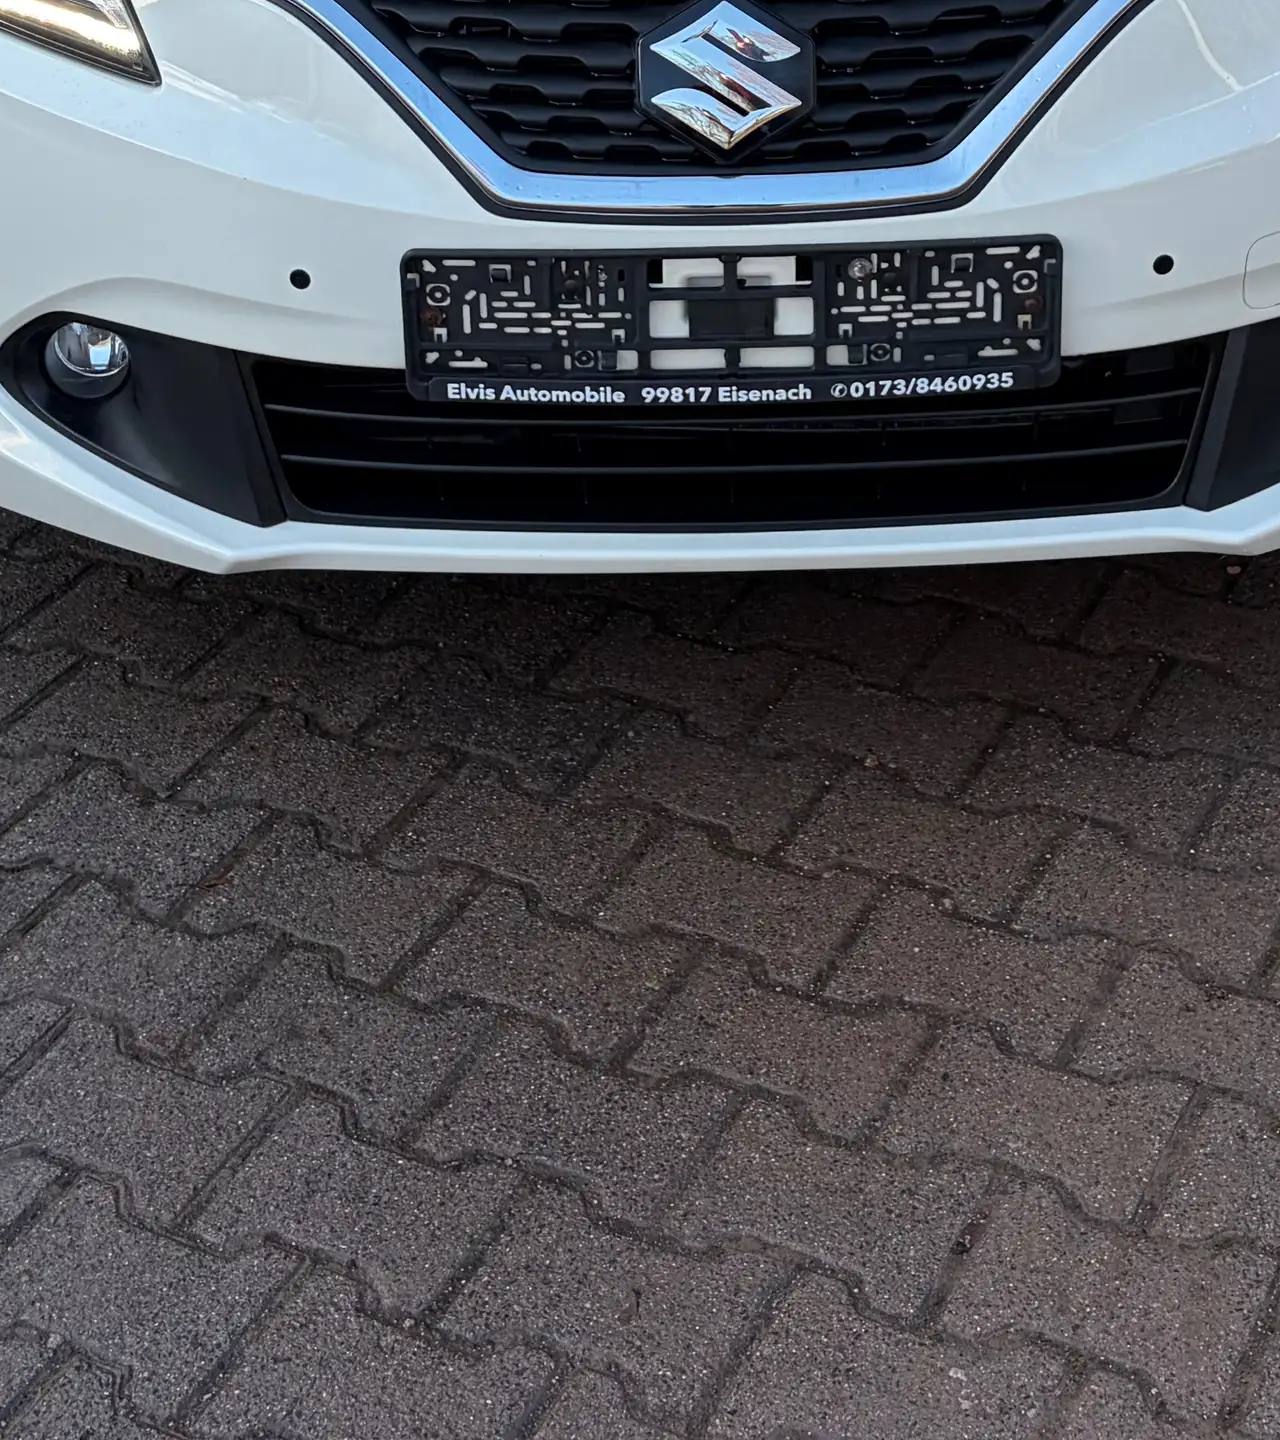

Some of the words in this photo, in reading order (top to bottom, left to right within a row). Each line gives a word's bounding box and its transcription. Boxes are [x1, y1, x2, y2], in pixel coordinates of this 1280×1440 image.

[447, 383, 495, 401] Elvis
[500, 385, 625, 403] Automobile
[641, 387, 712, 403] 99817
[718, 384, 812, 402] Eisenach
[850, 372, 1013, 397] 0173/8460935
